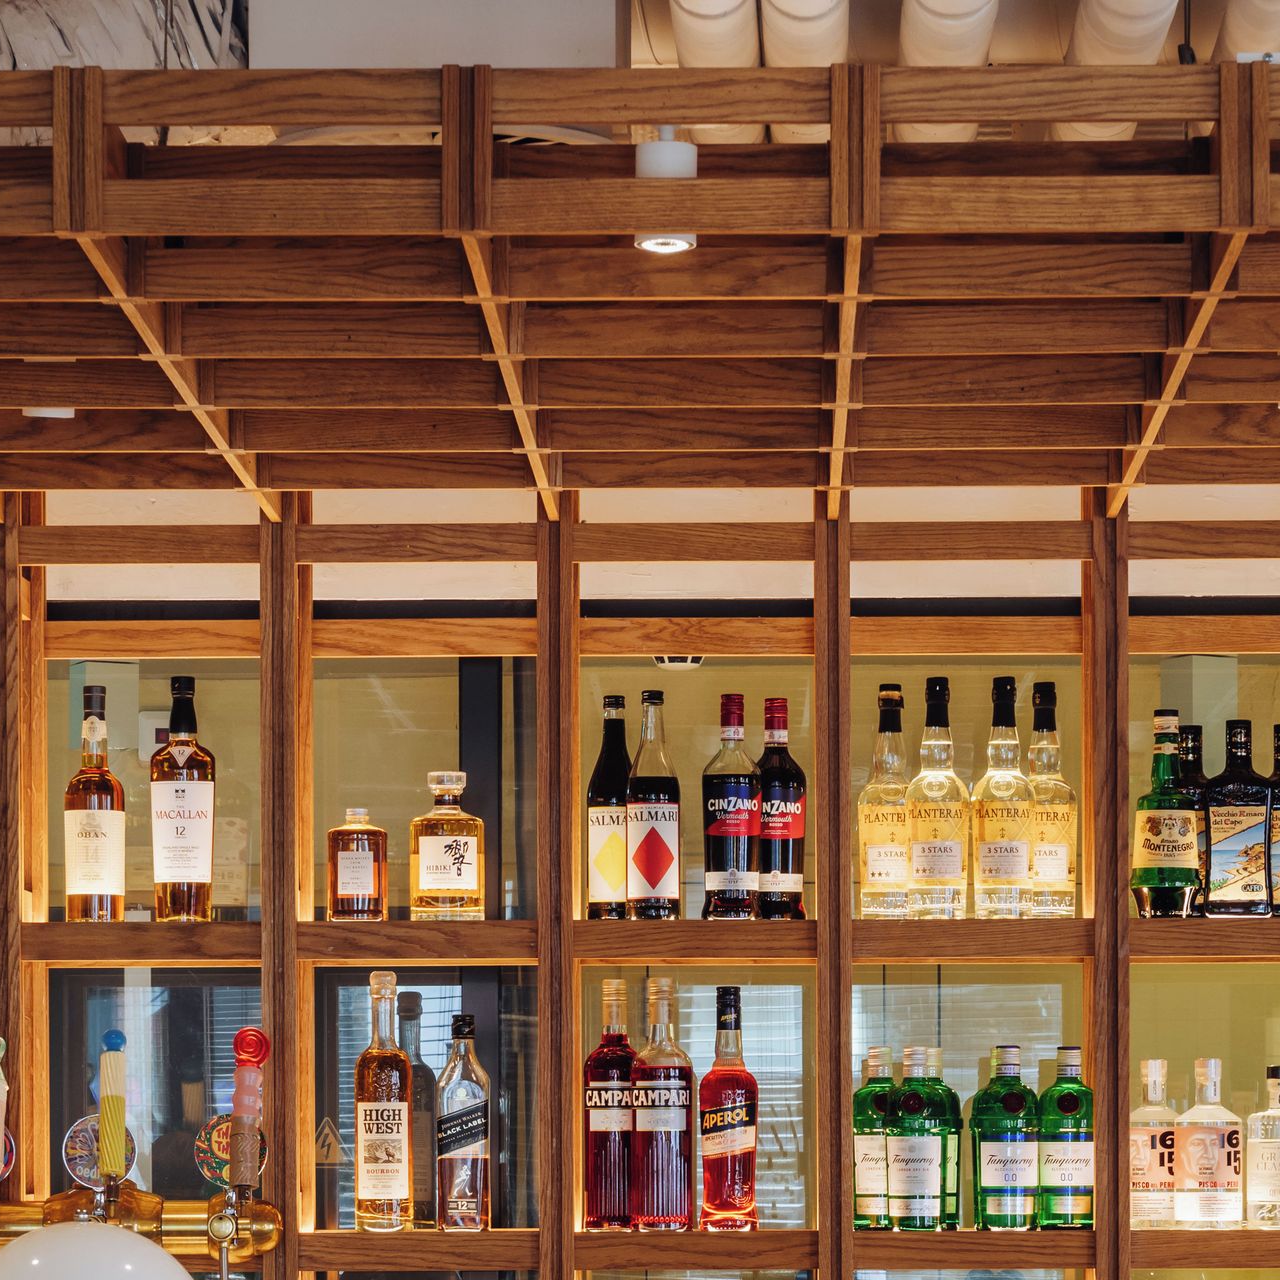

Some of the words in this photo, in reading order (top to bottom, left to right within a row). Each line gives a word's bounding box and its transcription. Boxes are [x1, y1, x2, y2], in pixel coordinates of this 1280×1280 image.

[707, 796, 759, 812] CINZANO
[762, 799, 802, 815] NZANO
[155, 809, 208, 820] MACALLAN
[628, 809, 678, 823] SALMARI
[715, 811, 749, 820] Vermouth
[761, 814, 793, 823] Vermouth
[908, 808, 964, 819] PLANTERAY
[975, 808, 1031, 819] PLANTERAY
[1211, 810, 1238, 818] Vecchio
[1212, 818, 1223, 826] del
[1223, 818, 1243, 827] Capo
[77, 831, 108, 839] OBAN
[175, 826, 186, 836] 12
[926, 846, 953, 854] STARS
[1142, 837, 1195, 852] MONTENEGRO
[992, 846, 1019, 855] STARS
[1242, 884, 1263, 892] CAFFO
[632, 1089, 690, 1107] CAMPARI
[363, 1108, 403, 1122] HIGH
[462, 1111, 483, 1122] WALKER
[702, 1107, 749, 1129] APEROL
[363, 1122, 403, 1135] WEST
[437, 1125, 462, 1139] BLACK
[462, 1117, 487, 1130] LABEL
[1151, 1130, 1174, 1150] 16
[1219, 1129, 1240, 1149] 16
[891, 1153, 934, 1167] Tanqueray
[986, 1153, 1034, 1167] Tanqueray
[1043, 1153, 1091, 1167] Tanqueray
[1226, 1149, 1241, 1176] 15
[1004, 1173, 1017, 1182] 0.0
[1060, 1173, 1073, 1182] 0.0
[1131, 1181, 1150, 1189] PISCO
[456, 1201, 468, 1210] 12
